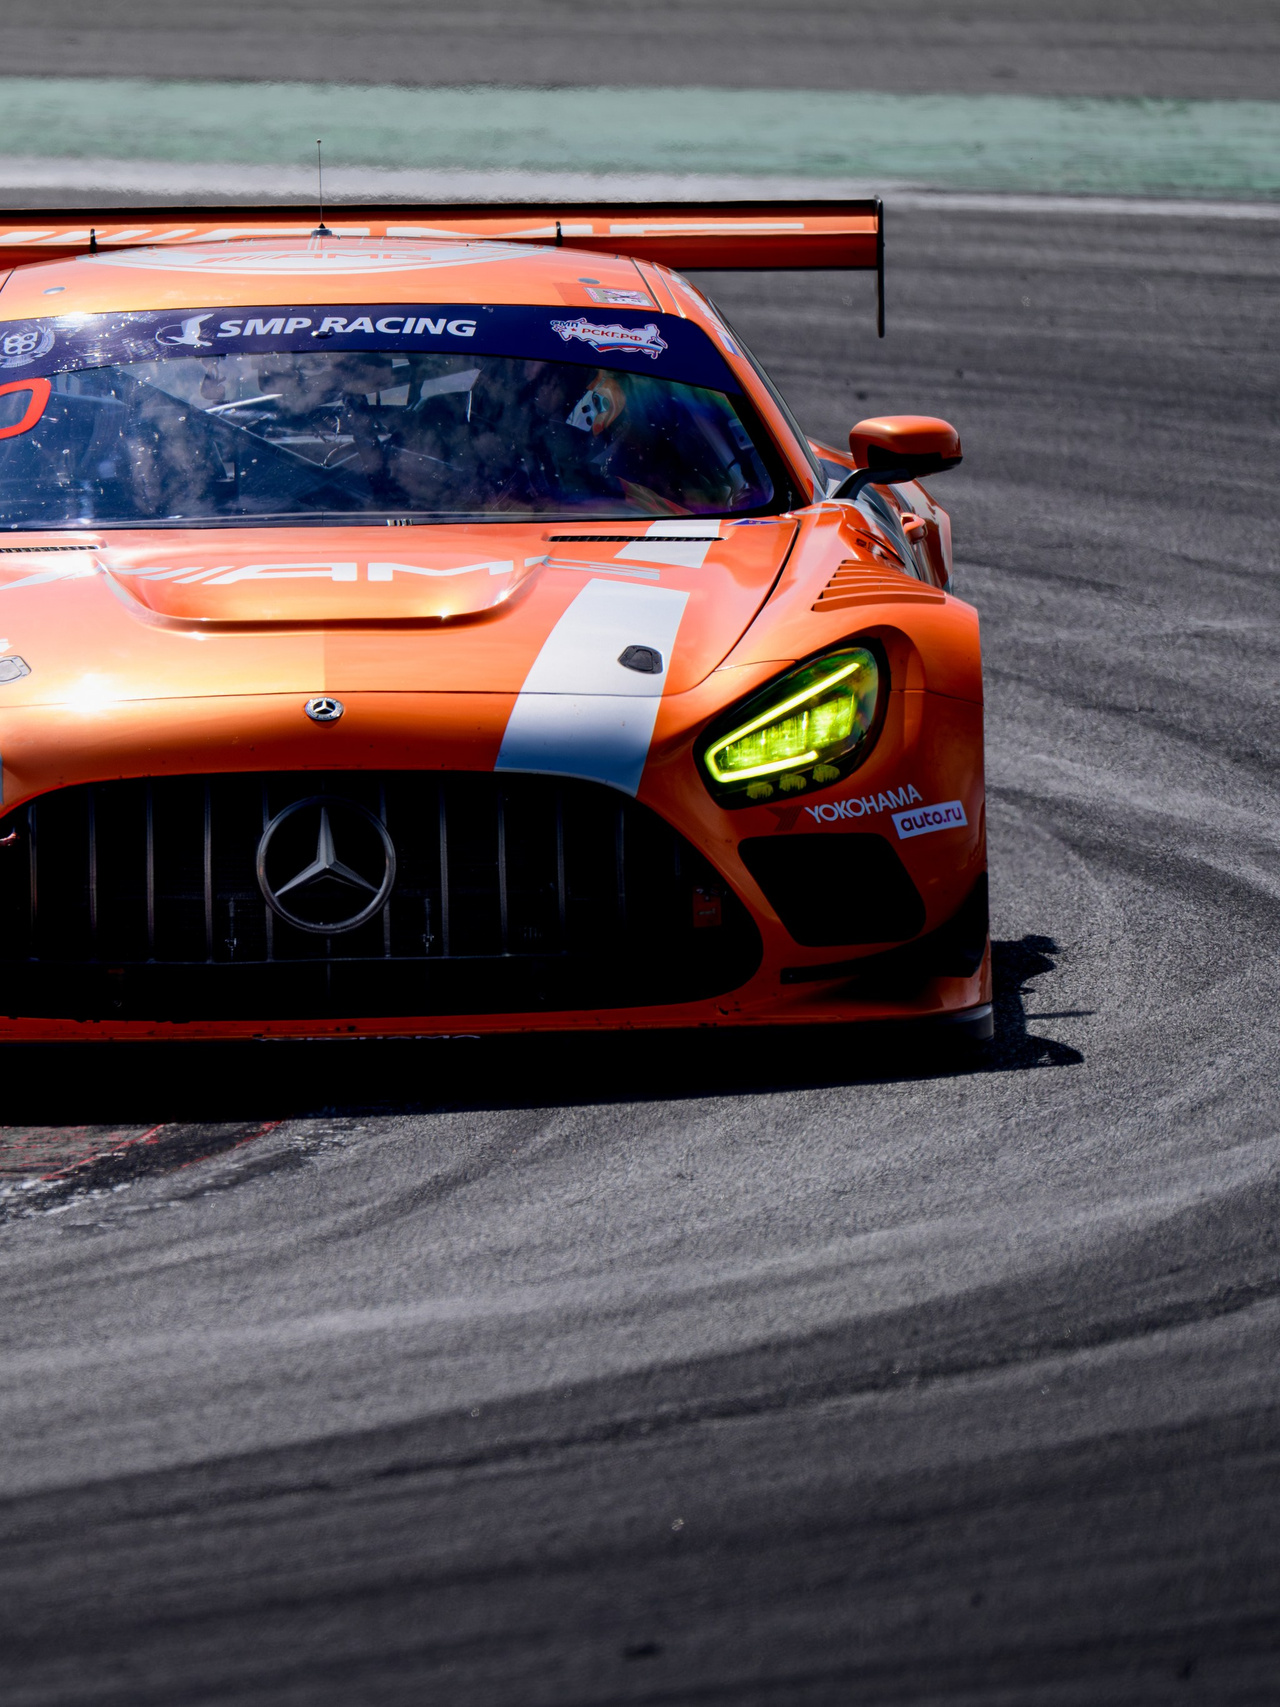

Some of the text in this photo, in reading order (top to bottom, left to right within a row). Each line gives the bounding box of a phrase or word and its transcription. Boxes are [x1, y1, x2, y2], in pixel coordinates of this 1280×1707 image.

[217, 316, 477, 338] SMP RACING
[804, 783, 924, 825] YOKOHAMA
[900, 806, 963, 832] auto.ru
